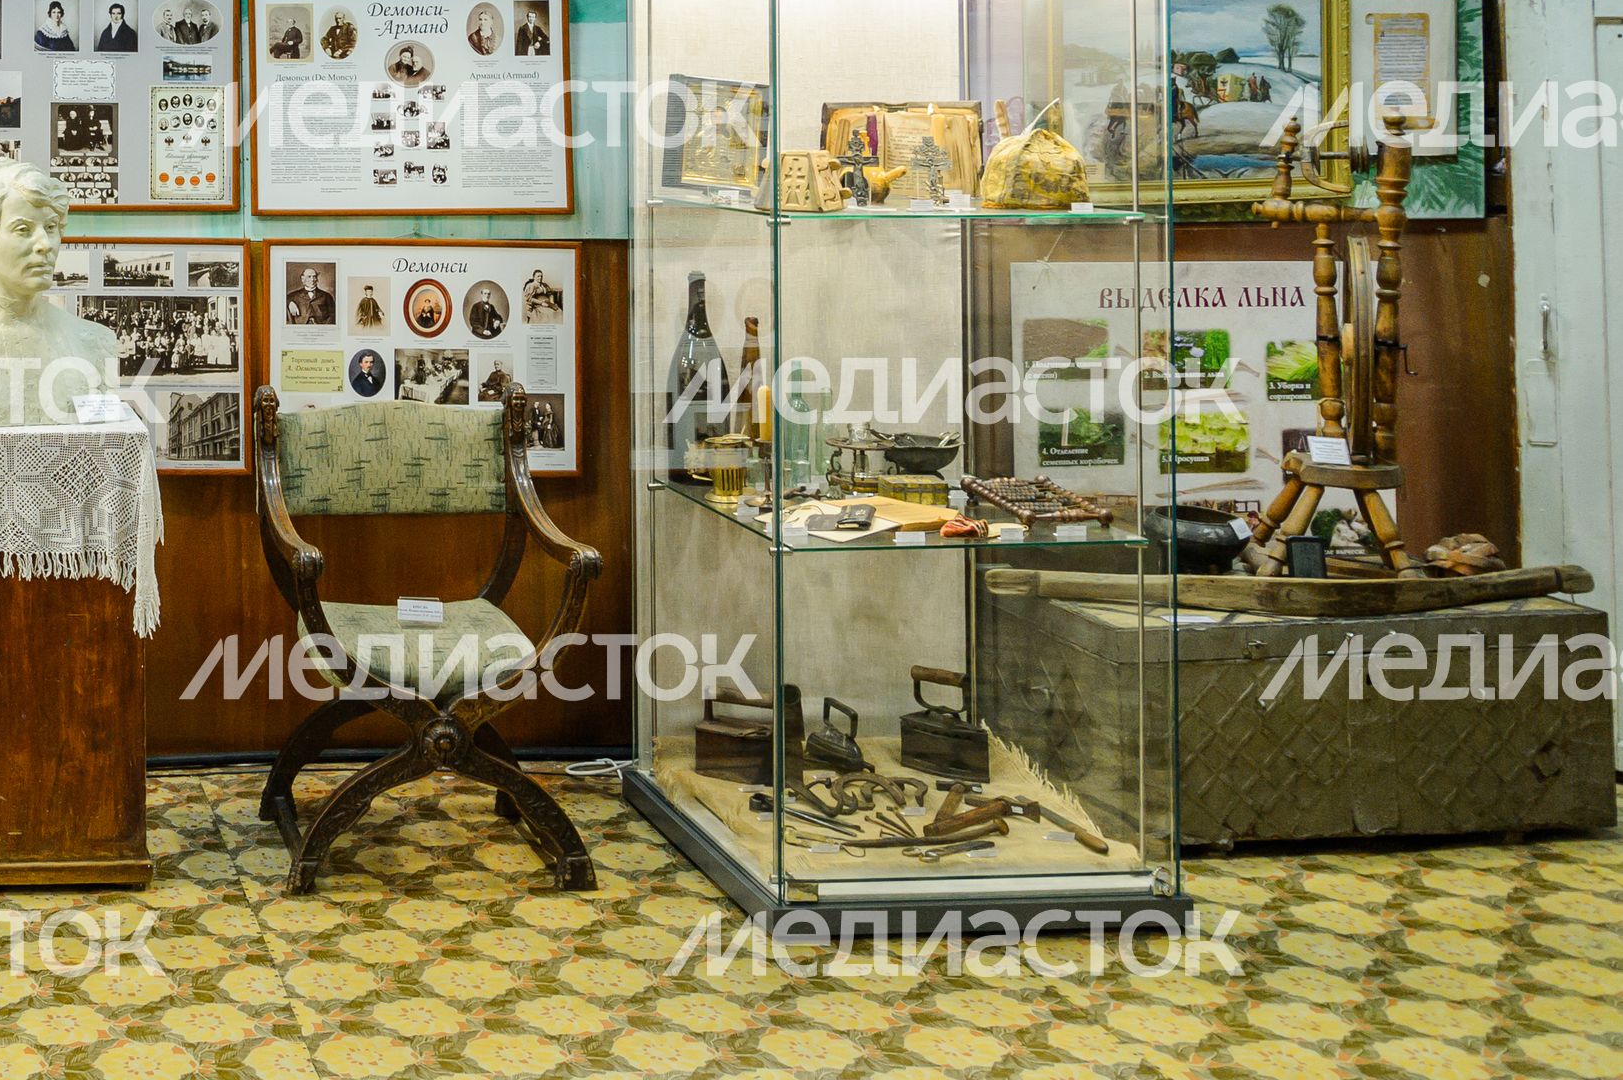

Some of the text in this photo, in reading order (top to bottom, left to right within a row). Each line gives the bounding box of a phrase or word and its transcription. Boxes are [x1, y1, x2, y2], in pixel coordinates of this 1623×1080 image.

[392, 257, 468, 274] Демонси
[1098, 285, 1306, 312] ВЫДЕЛКА ЛЬНА
